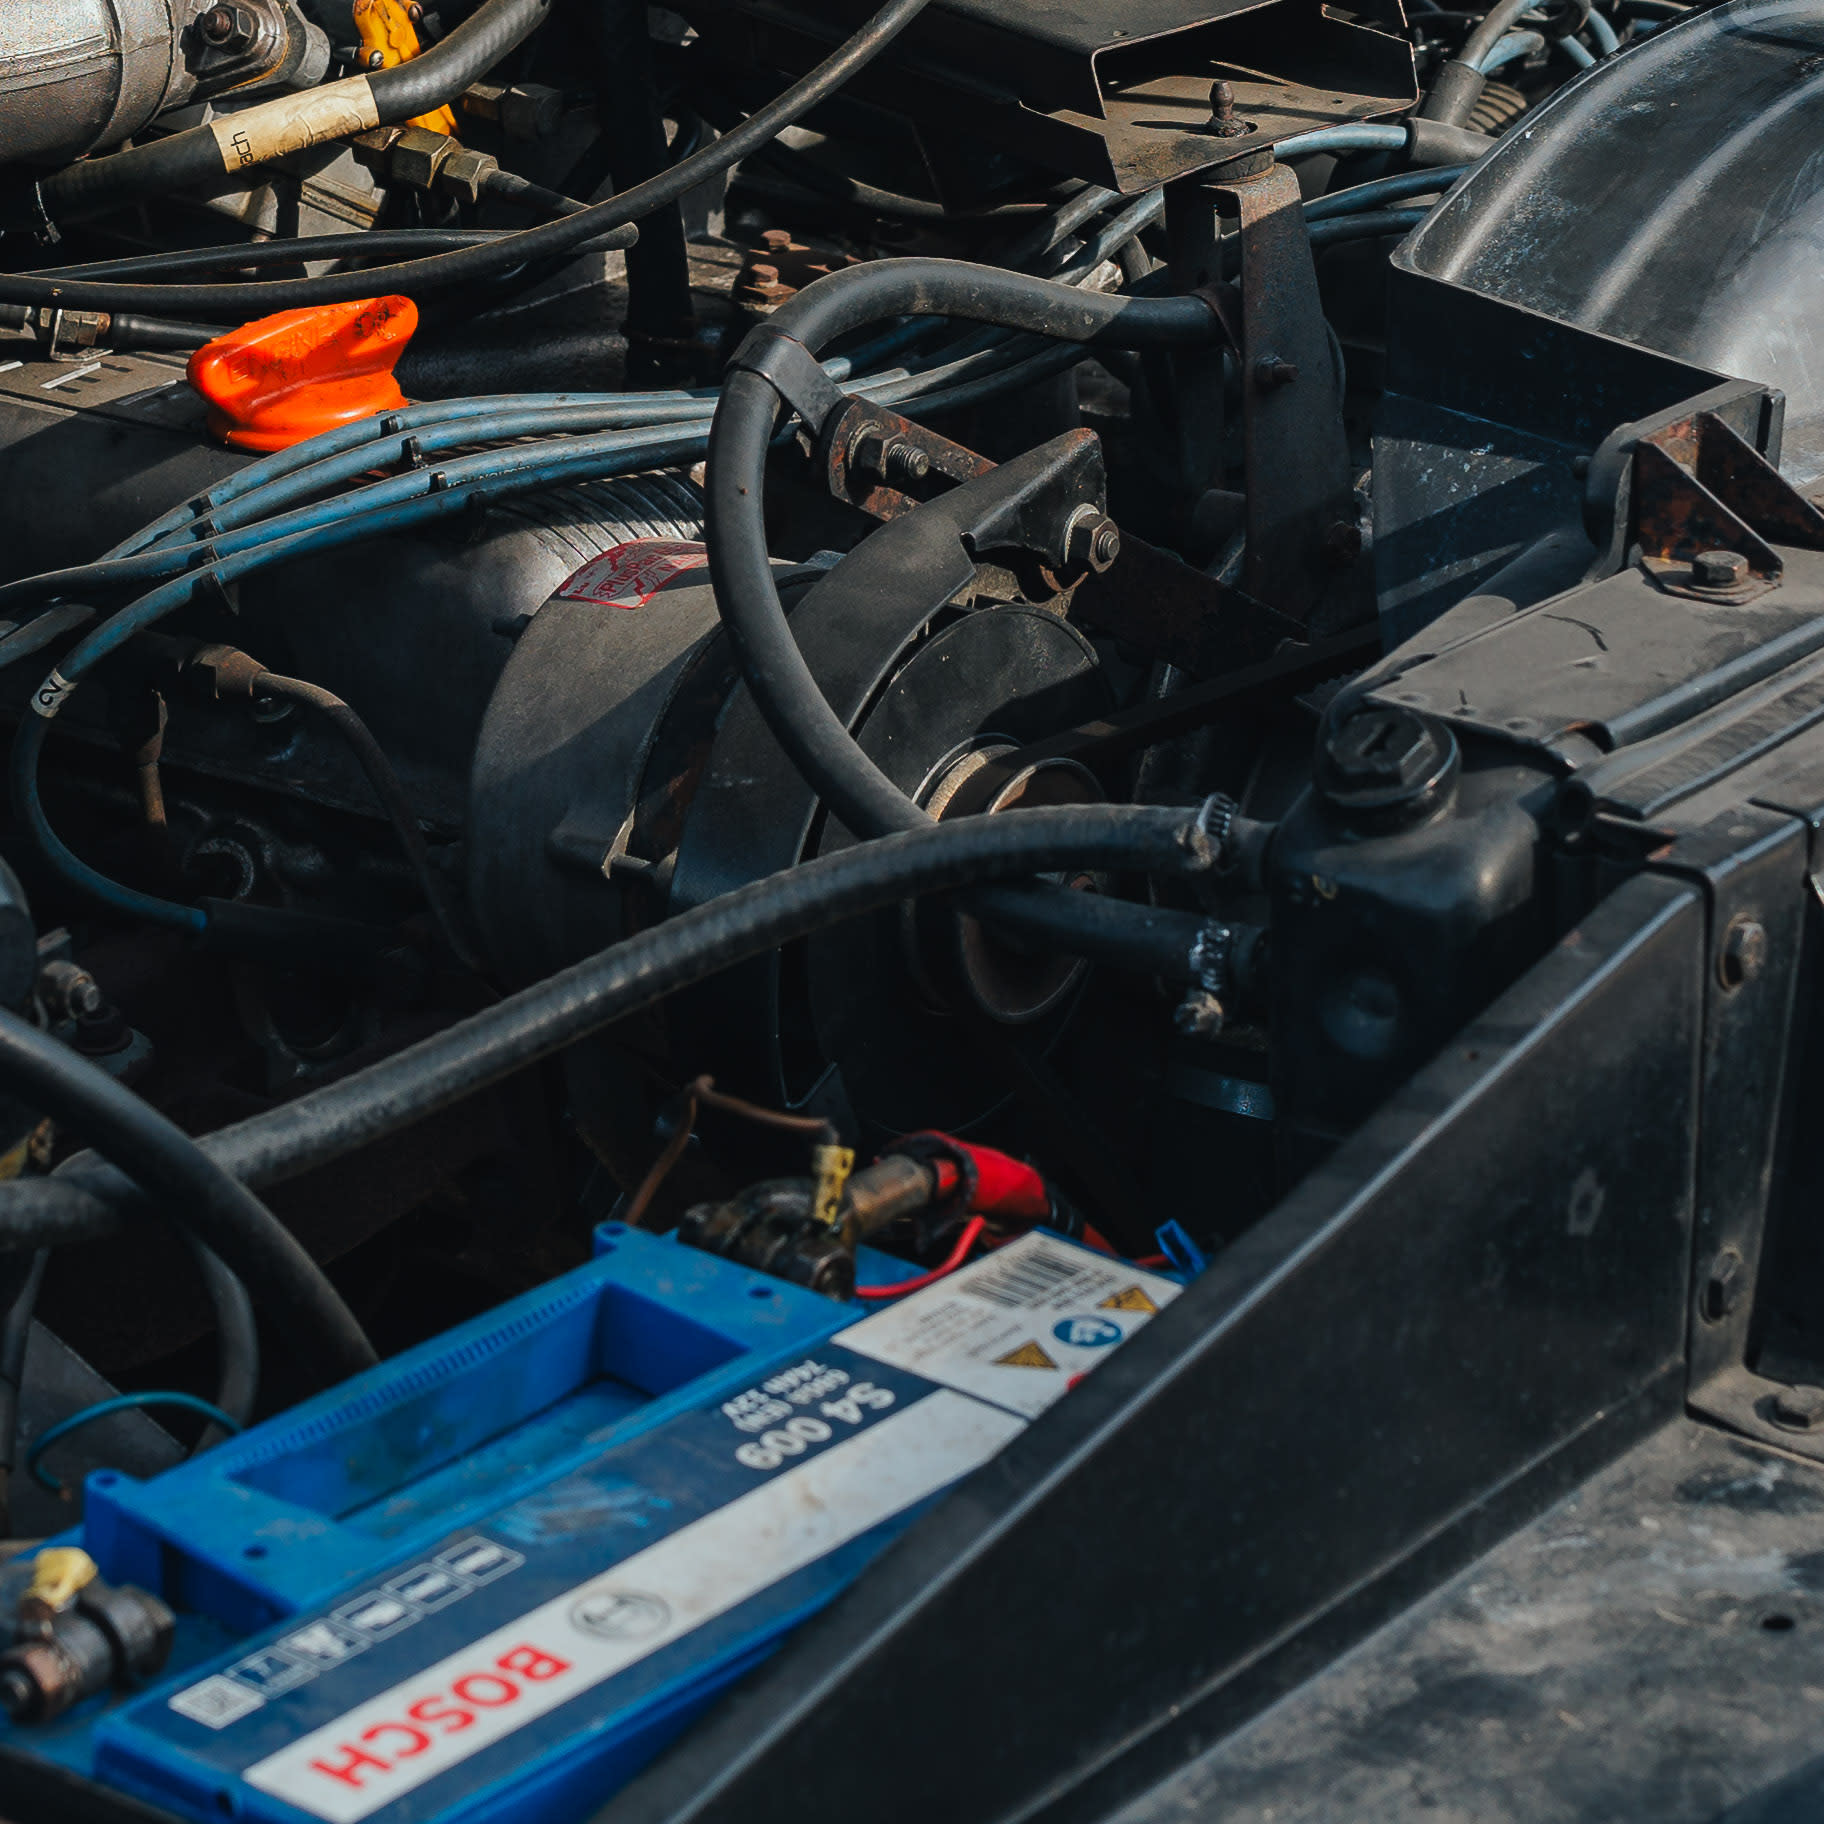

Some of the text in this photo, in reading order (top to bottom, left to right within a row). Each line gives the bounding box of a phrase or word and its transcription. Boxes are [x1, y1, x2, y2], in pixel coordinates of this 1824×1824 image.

[38, 677, 63, 707] 2
[735, 1381, 896, 1470] S4 009
[308, 1642, 574, 1788] BOSCH
